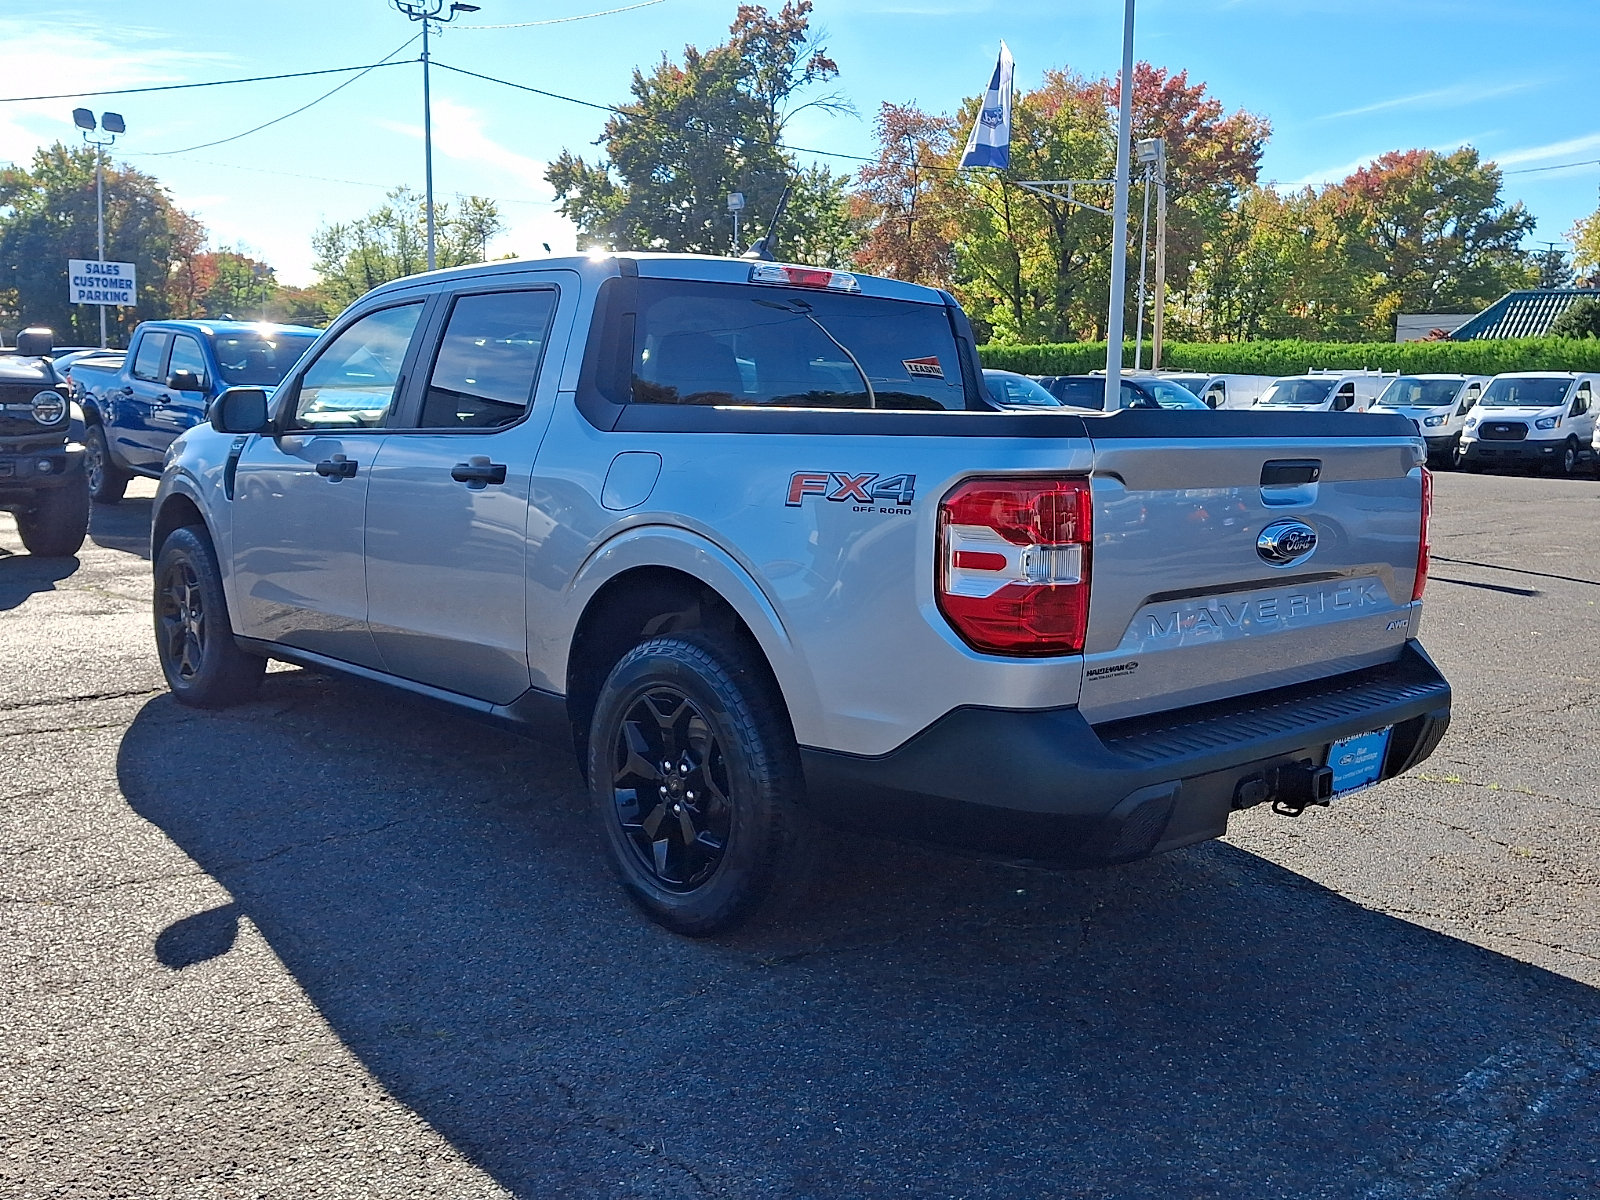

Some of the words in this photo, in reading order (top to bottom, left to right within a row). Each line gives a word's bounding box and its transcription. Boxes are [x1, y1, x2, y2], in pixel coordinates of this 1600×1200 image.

[85, 263, 120, 276] SALES
[73, 276, 133, 289] CUSTOMER
[78, 289, 129, 302] PARKING
[785, 470, 917, 508] FX4
[852, 505, 876, 513] OFF
[879, 507, 912, 516] ROAD
[1286, 531, 1311, 551] Ford
[1148, 583, 1378, 638] MAVERICK
[1386, 619, 1409, 631] AWD
